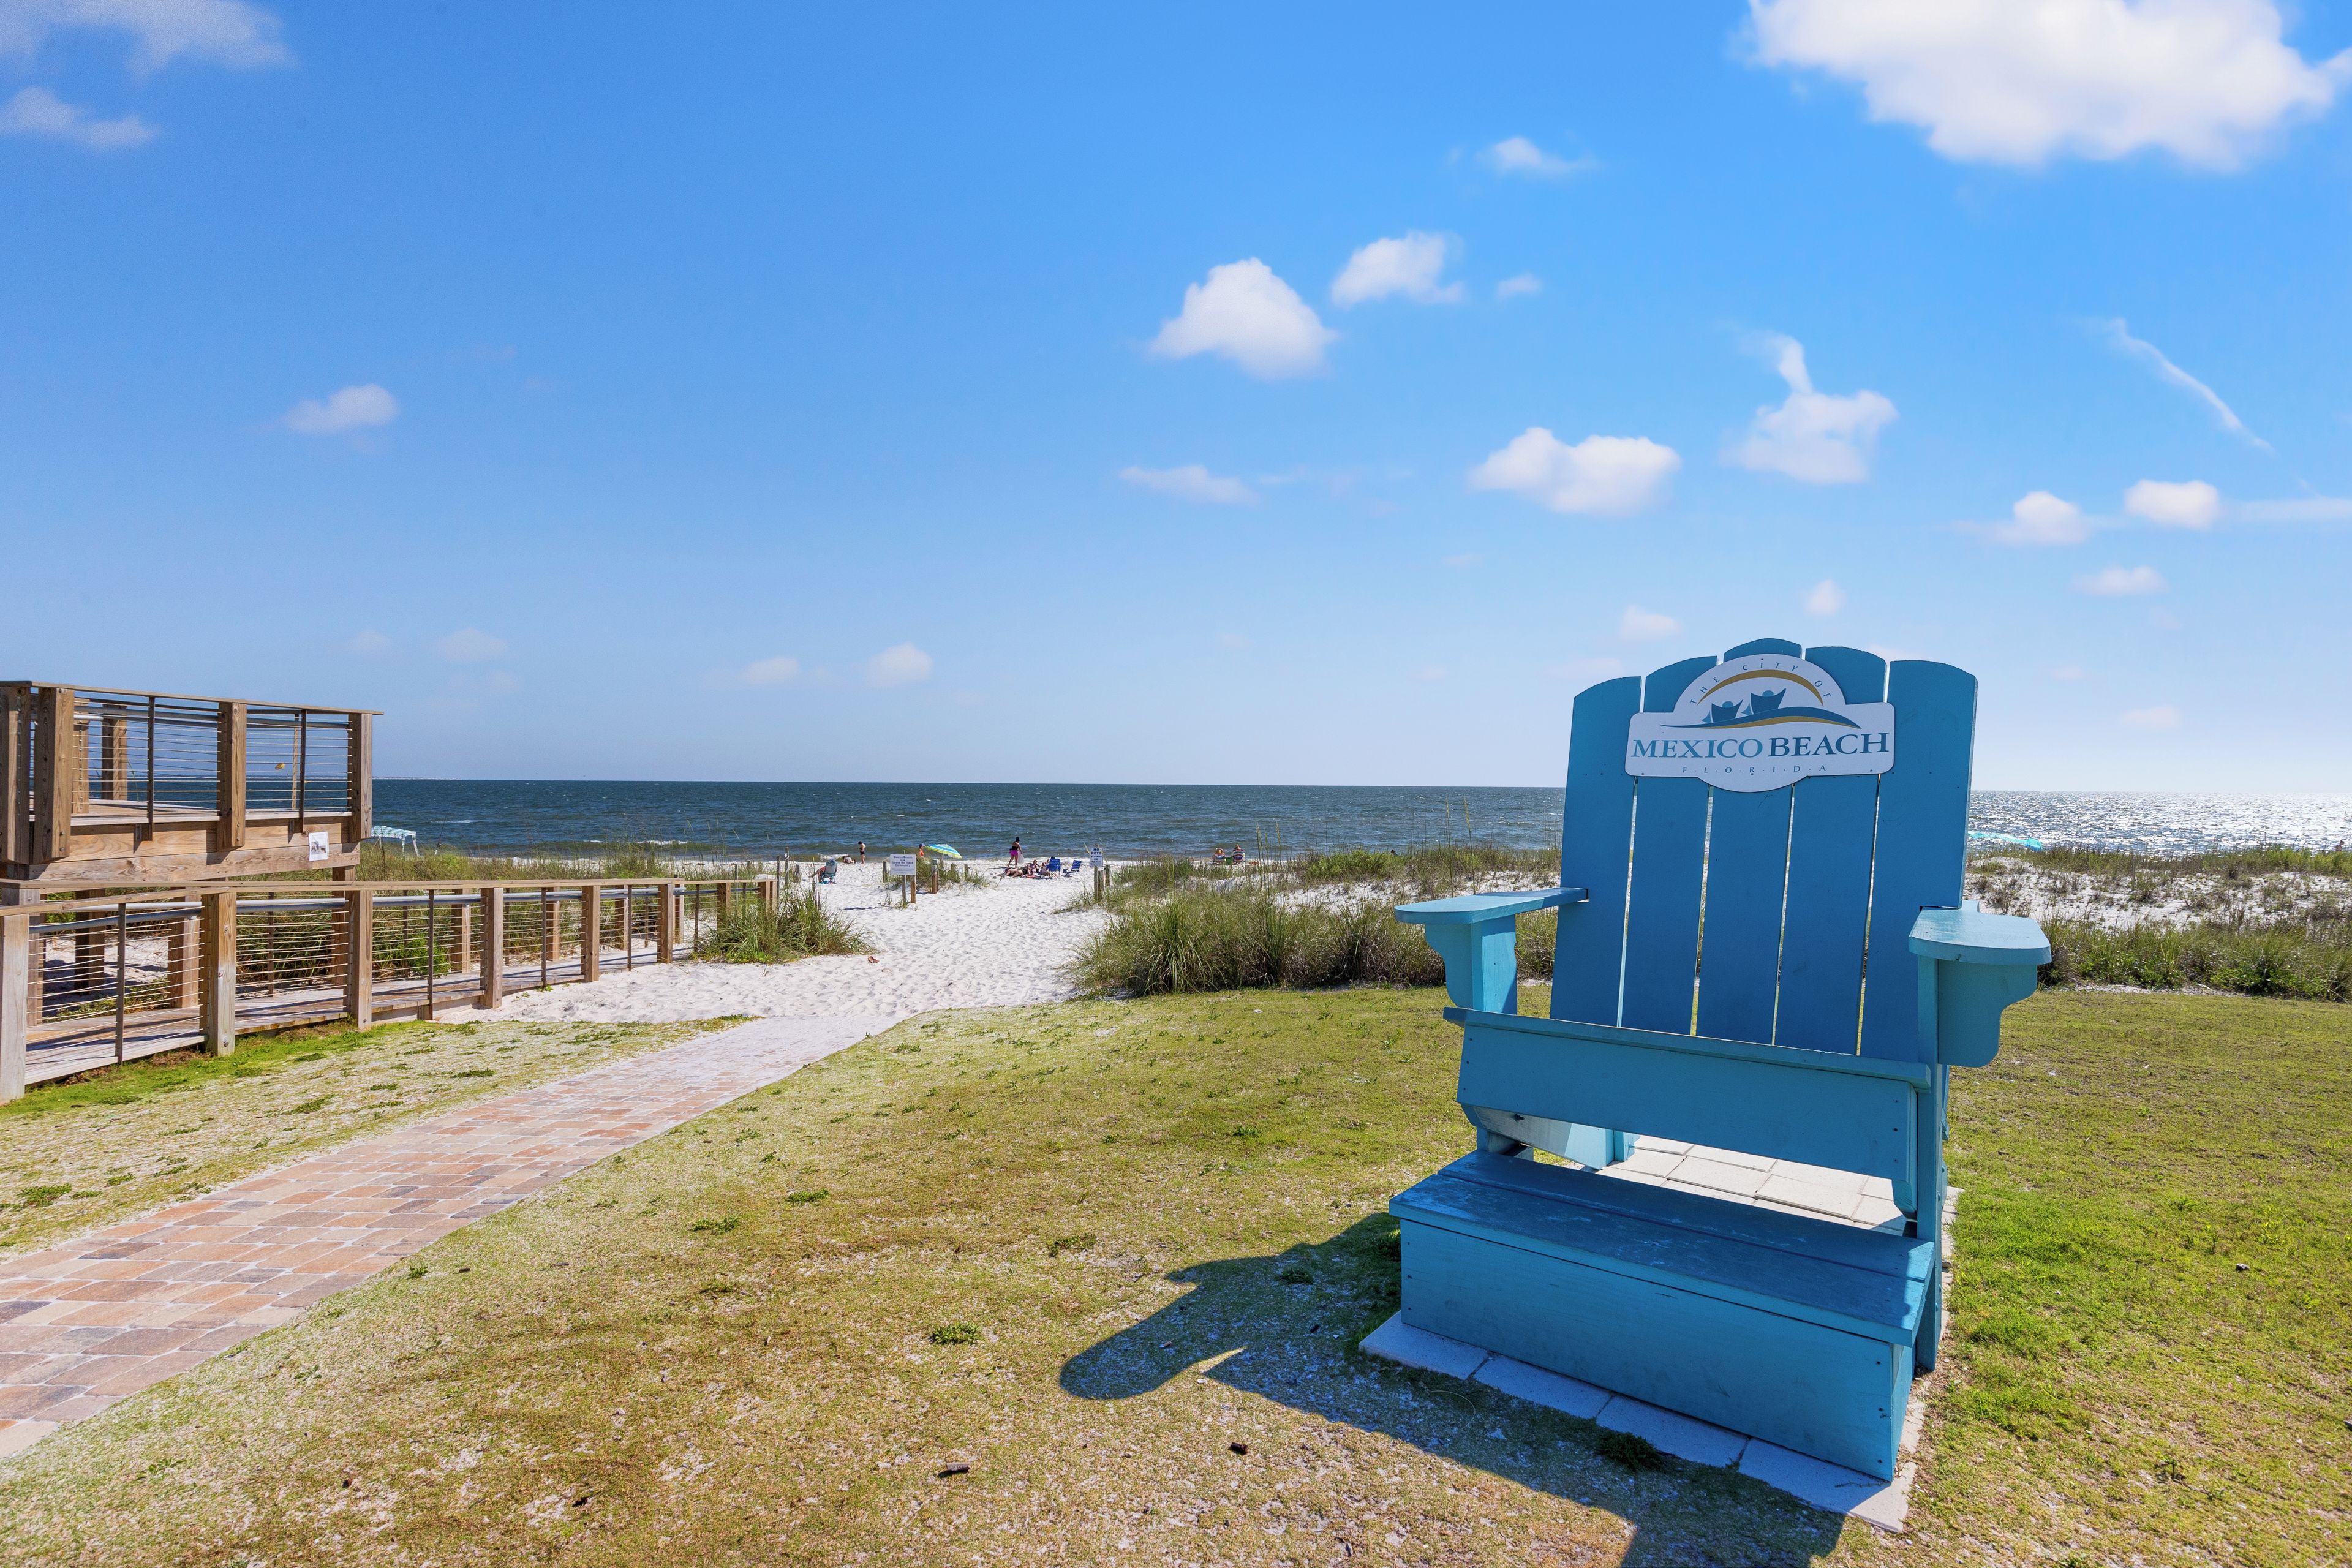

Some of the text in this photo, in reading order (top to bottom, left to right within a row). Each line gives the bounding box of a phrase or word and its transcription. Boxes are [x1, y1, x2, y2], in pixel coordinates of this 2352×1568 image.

[1689, 662, 1832, 705] THE CITY OF
[1630, 732, 1890, 758] MEXICO BEACH
